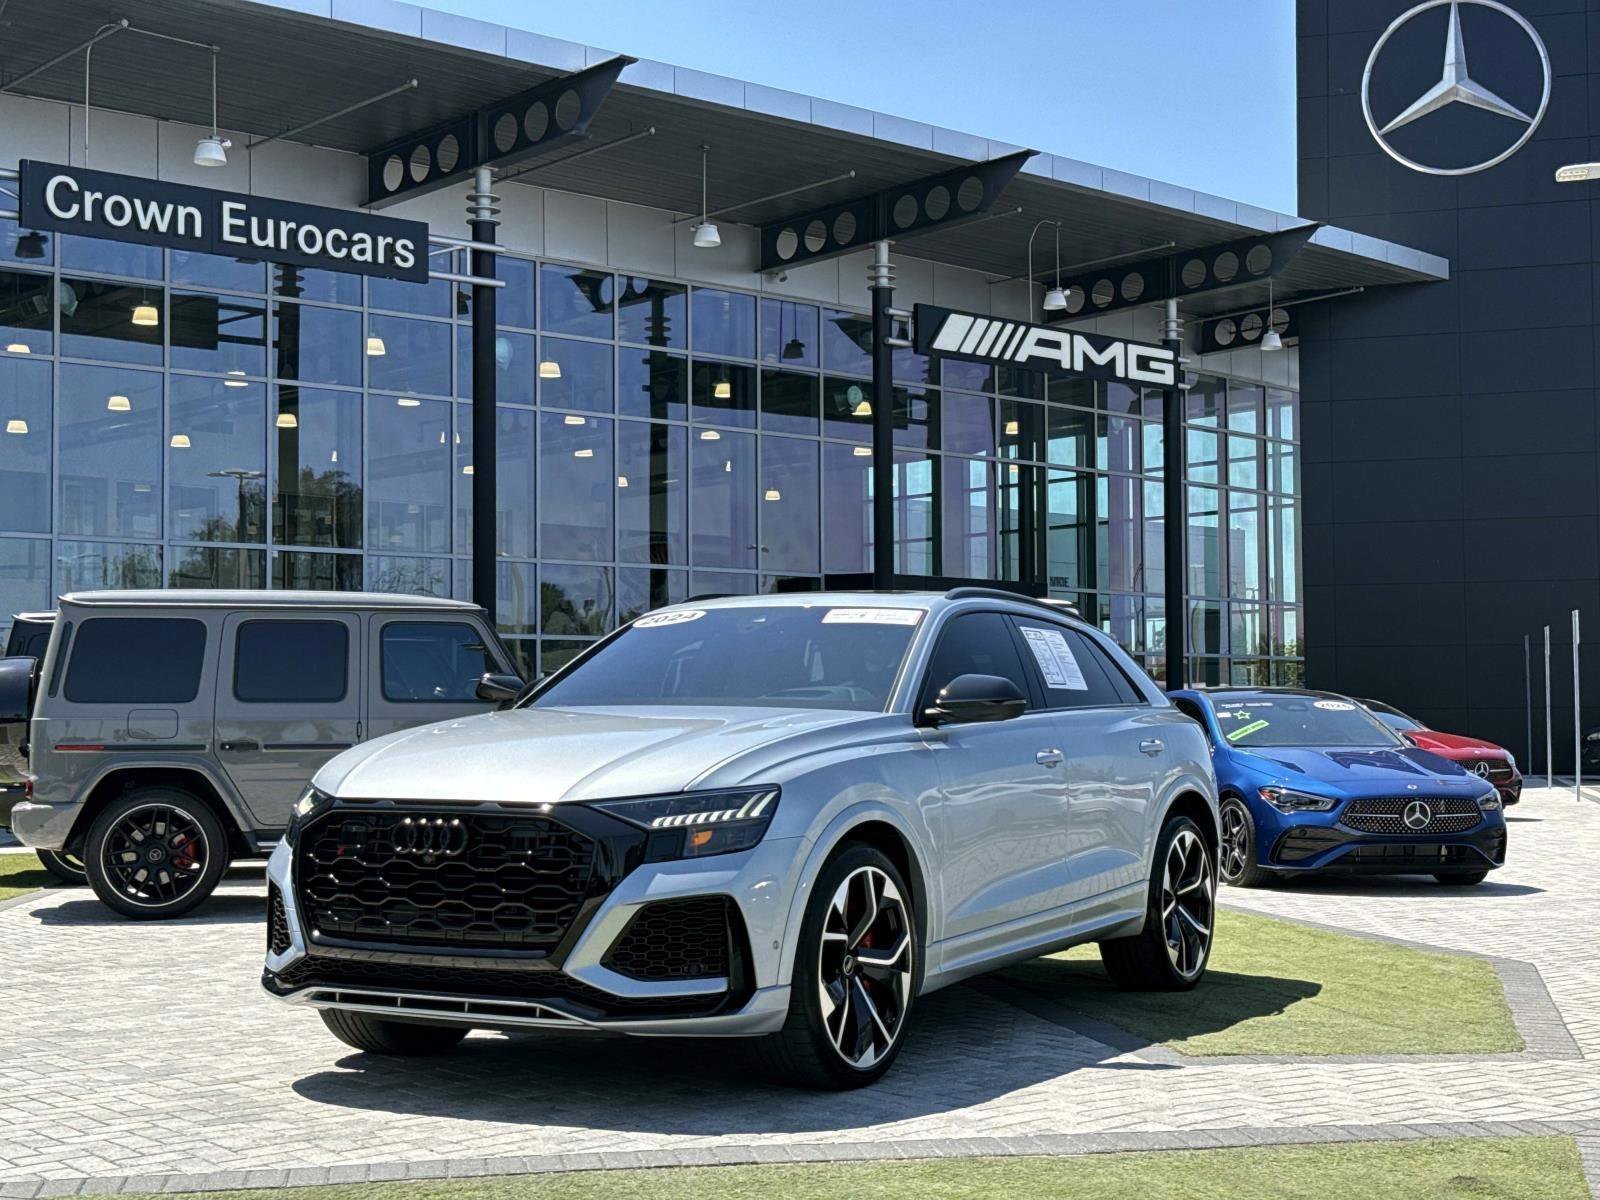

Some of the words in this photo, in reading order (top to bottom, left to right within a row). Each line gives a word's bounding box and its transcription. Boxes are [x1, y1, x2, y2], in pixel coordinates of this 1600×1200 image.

[45, 175, 201, 237] Crown
[222, 201, 415, 268] Eurocars
[1014, 327, 1174, 385] AMG
[640, 612, 697, 625] 2024
